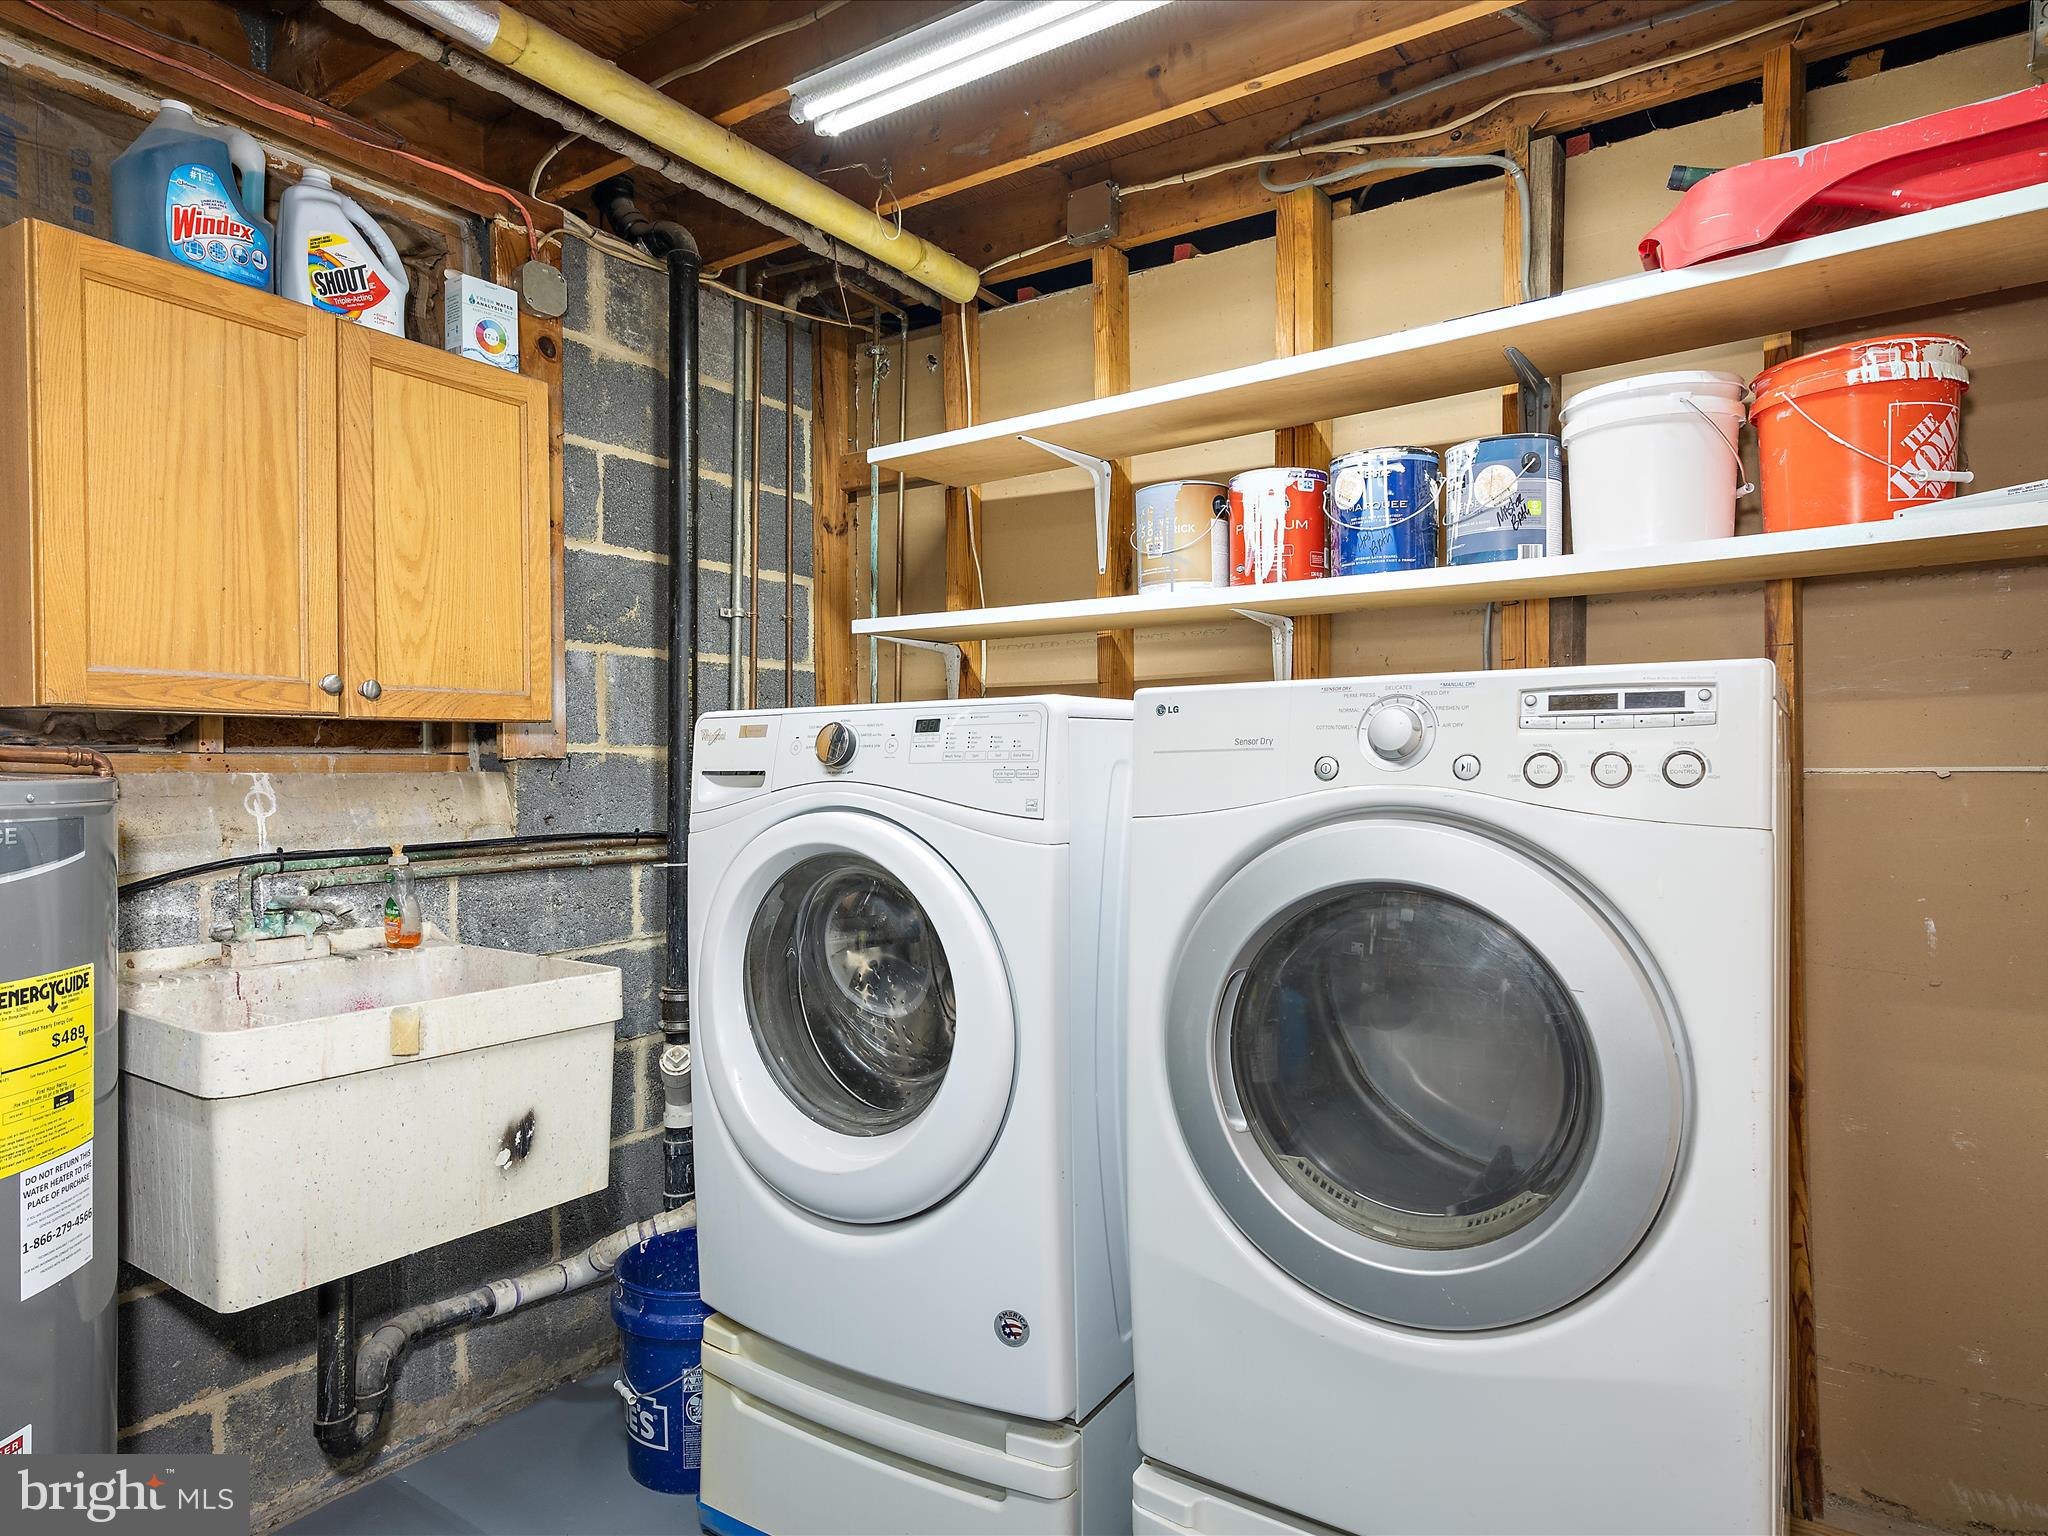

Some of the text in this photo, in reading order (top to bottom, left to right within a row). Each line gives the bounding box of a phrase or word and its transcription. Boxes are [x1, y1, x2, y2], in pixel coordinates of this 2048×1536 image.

[172, 205, 255, 243] Windex
[313, 264, 367, 296] SHOUT
[334, 293, 374, 305] Triple-Acting
[476, 301, 503, 313] ANALYSIS
[495, 300, 513, 311] WATER
[1900, 412, 1940, 452] THE
[1167, 705, 1180, 714] LG
[1234, 736, 1274, 747] Sensor Dry
[0, 971, 90, 1010] ENERGYGUIDE
[18, 1025, 40, 1037] Estimated
[51, 1024, 86, 1048] $489
[22, 1159, 92, 1200] WATER HEATER TO THE
[25, 1149, 91, 1187] DO NOT RETURN THIS
[26, 1193, 50, 1211] PLACE
[50, 1188, 61, 1201] OF
[61, 1172, 90, 1195] PURCHASE
[22, 1207, 93, 1255] 1-866-279-4566
[998, 1311, 1028, 1330] AMERICA
